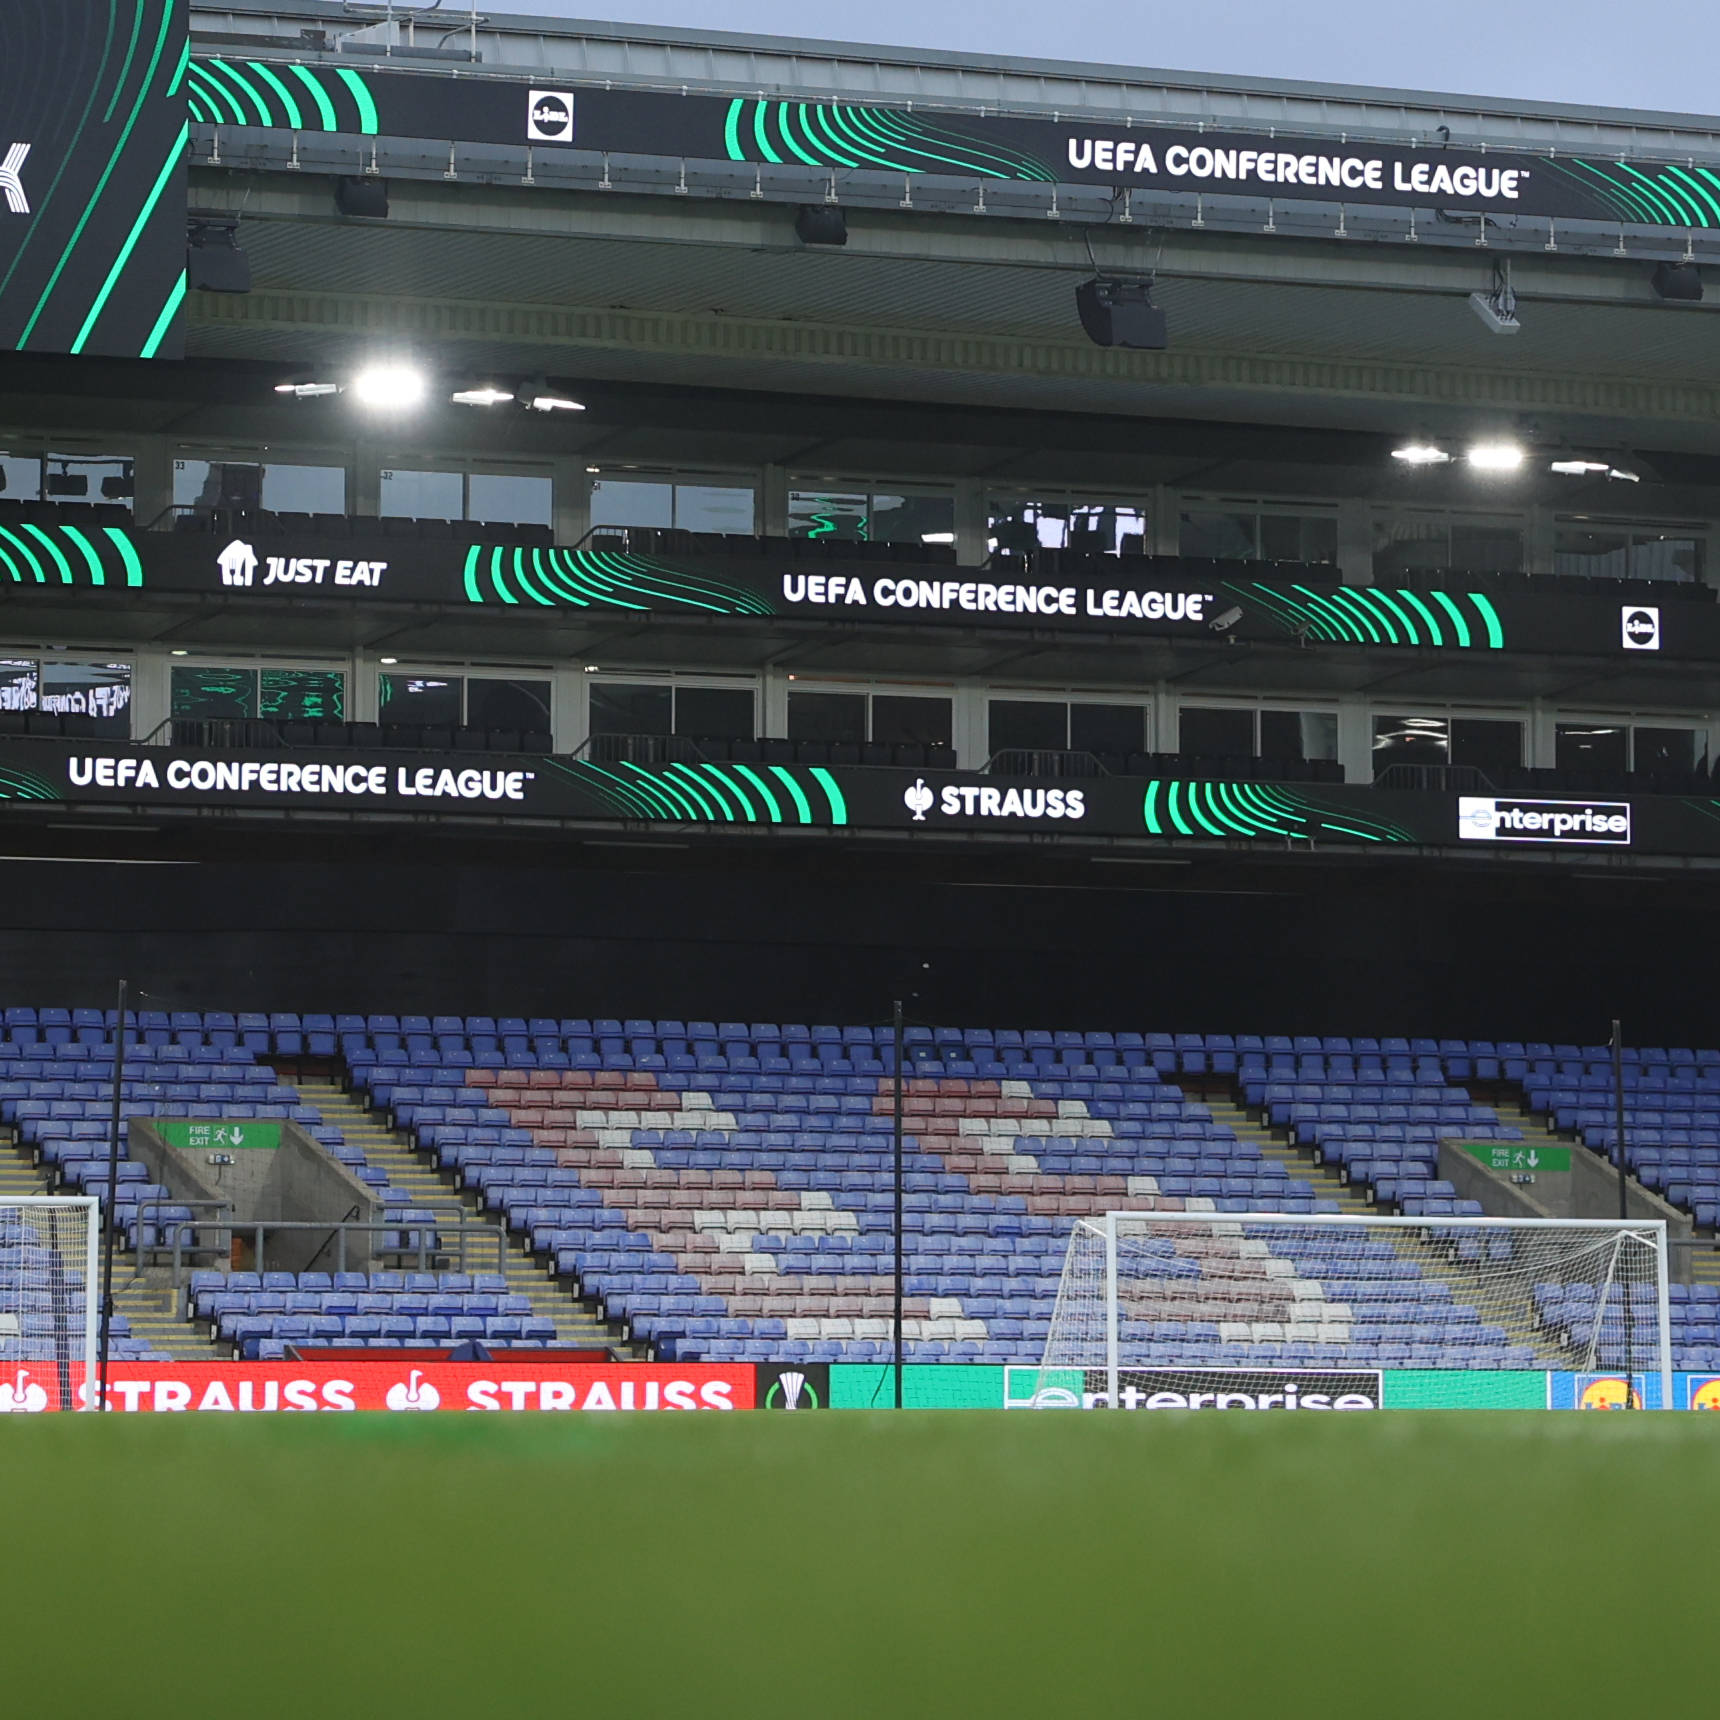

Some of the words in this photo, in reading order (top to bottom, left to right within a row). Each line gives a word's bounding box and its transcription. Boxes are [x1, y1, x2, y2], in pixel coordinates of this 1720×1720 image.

[1069, 139, 1158, 173] UEFA
[1165, 145, 1382, 190] CONFERENCE
[263, 557, 331, 585] JUST
[335, 560, 387, 586] EAT
[784, 575, 867, 605] UEFA
[874, 579, 1076, 614] CONFERENCE
[70, 757, 159, 787] UEFA
[167, 760, 386, 794] CONFERENCE
[941, 786, 1084, 818] STRAUSS
[1471, 807, 1628, 837] enterprise
[189, 1126, 210, 1135] FIRE
[189, 1137, 209, 1146] EXIT
[1492, 1148, 1509, 1157] FIRE
[1492, 1158, 1509, 1168] EXIT
[78, 1380, 356, 1411] STRAUSS
[466, 1380, 733, 1411] STRAUSS
